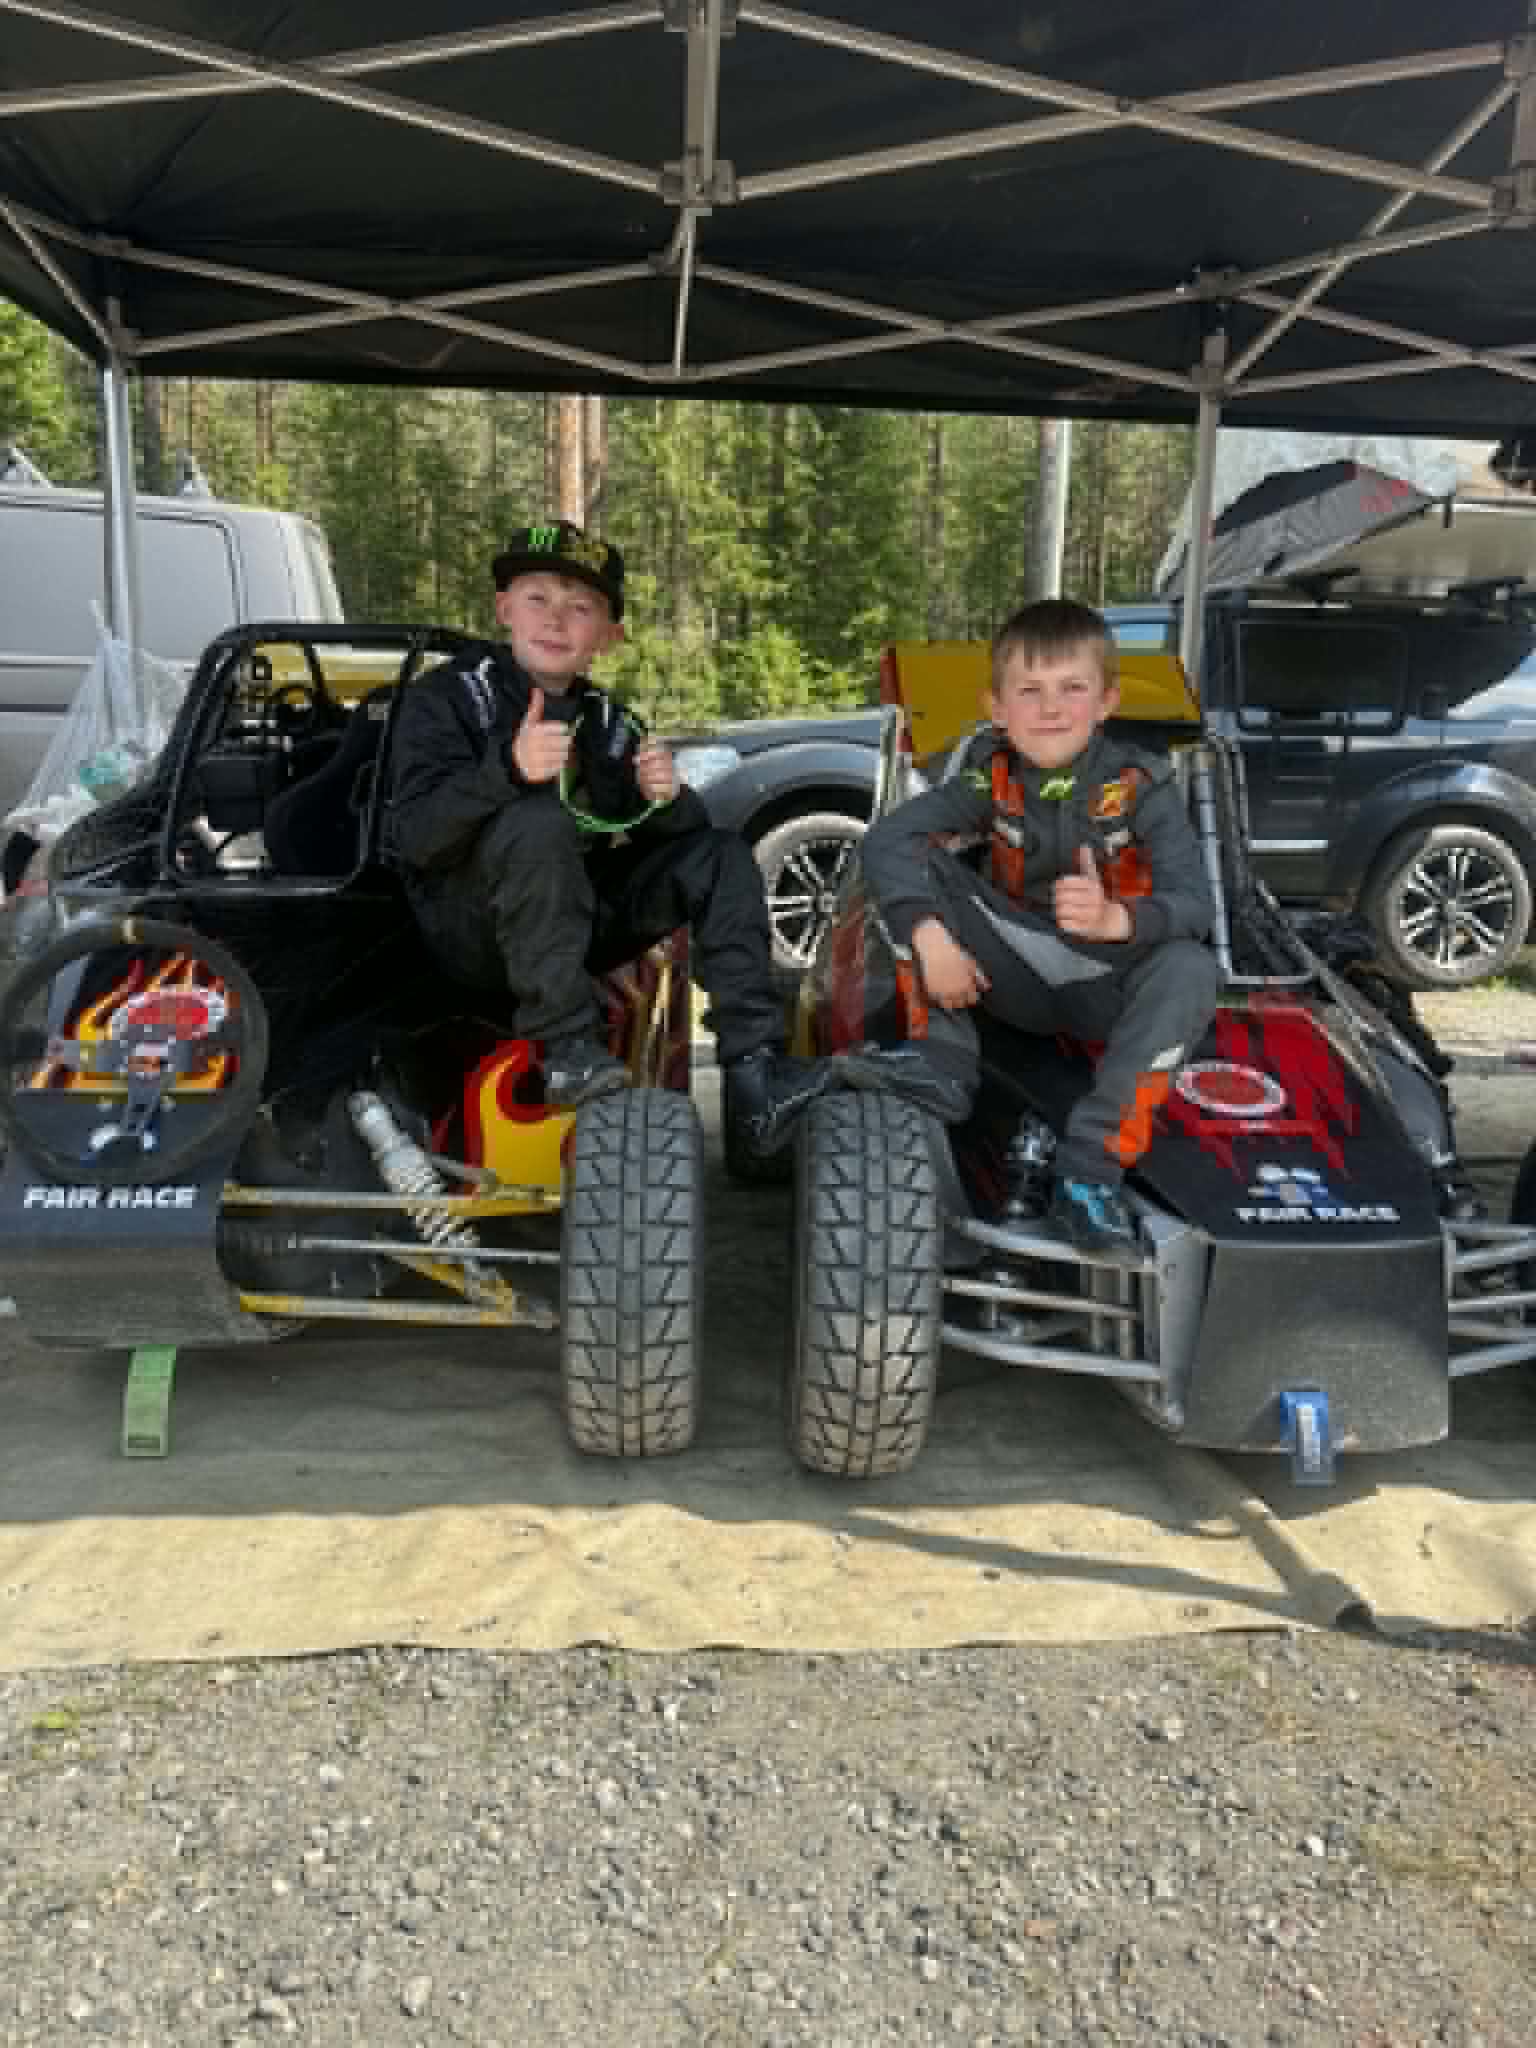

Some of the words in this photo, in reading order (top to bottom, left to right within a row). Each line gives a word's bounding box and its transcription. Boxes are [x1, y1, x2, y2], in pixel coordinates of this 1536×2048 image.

[24, 1186, 97, 1208] FAIR
[103, 1186, 197, 1208] RACE
[1234, 1206, 1310, 1223] FAIR
[1313, 1206, 1399, 1223] RACE
